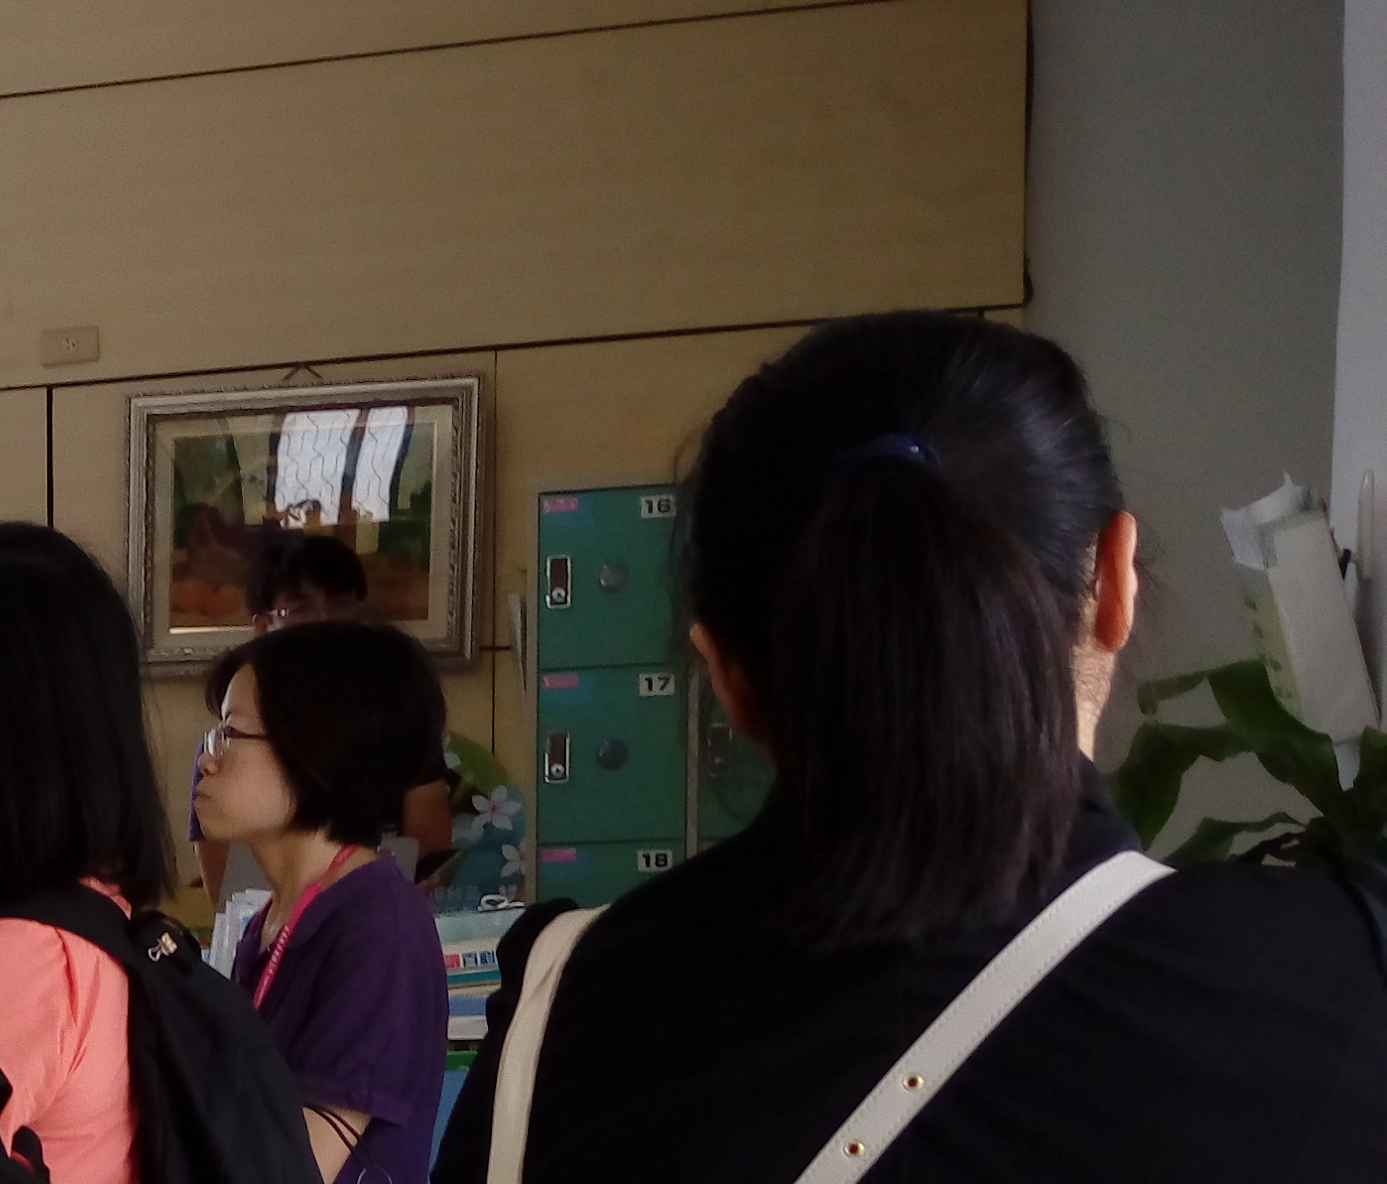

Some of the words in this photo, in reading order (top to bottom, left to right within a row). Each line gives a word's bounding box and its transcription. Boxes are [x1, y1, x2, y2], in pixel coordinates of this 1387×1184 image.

[644, 498, 671, 515] 16
[643, 676, 671, 693] 17
[642, 852, 669, 869] 18
